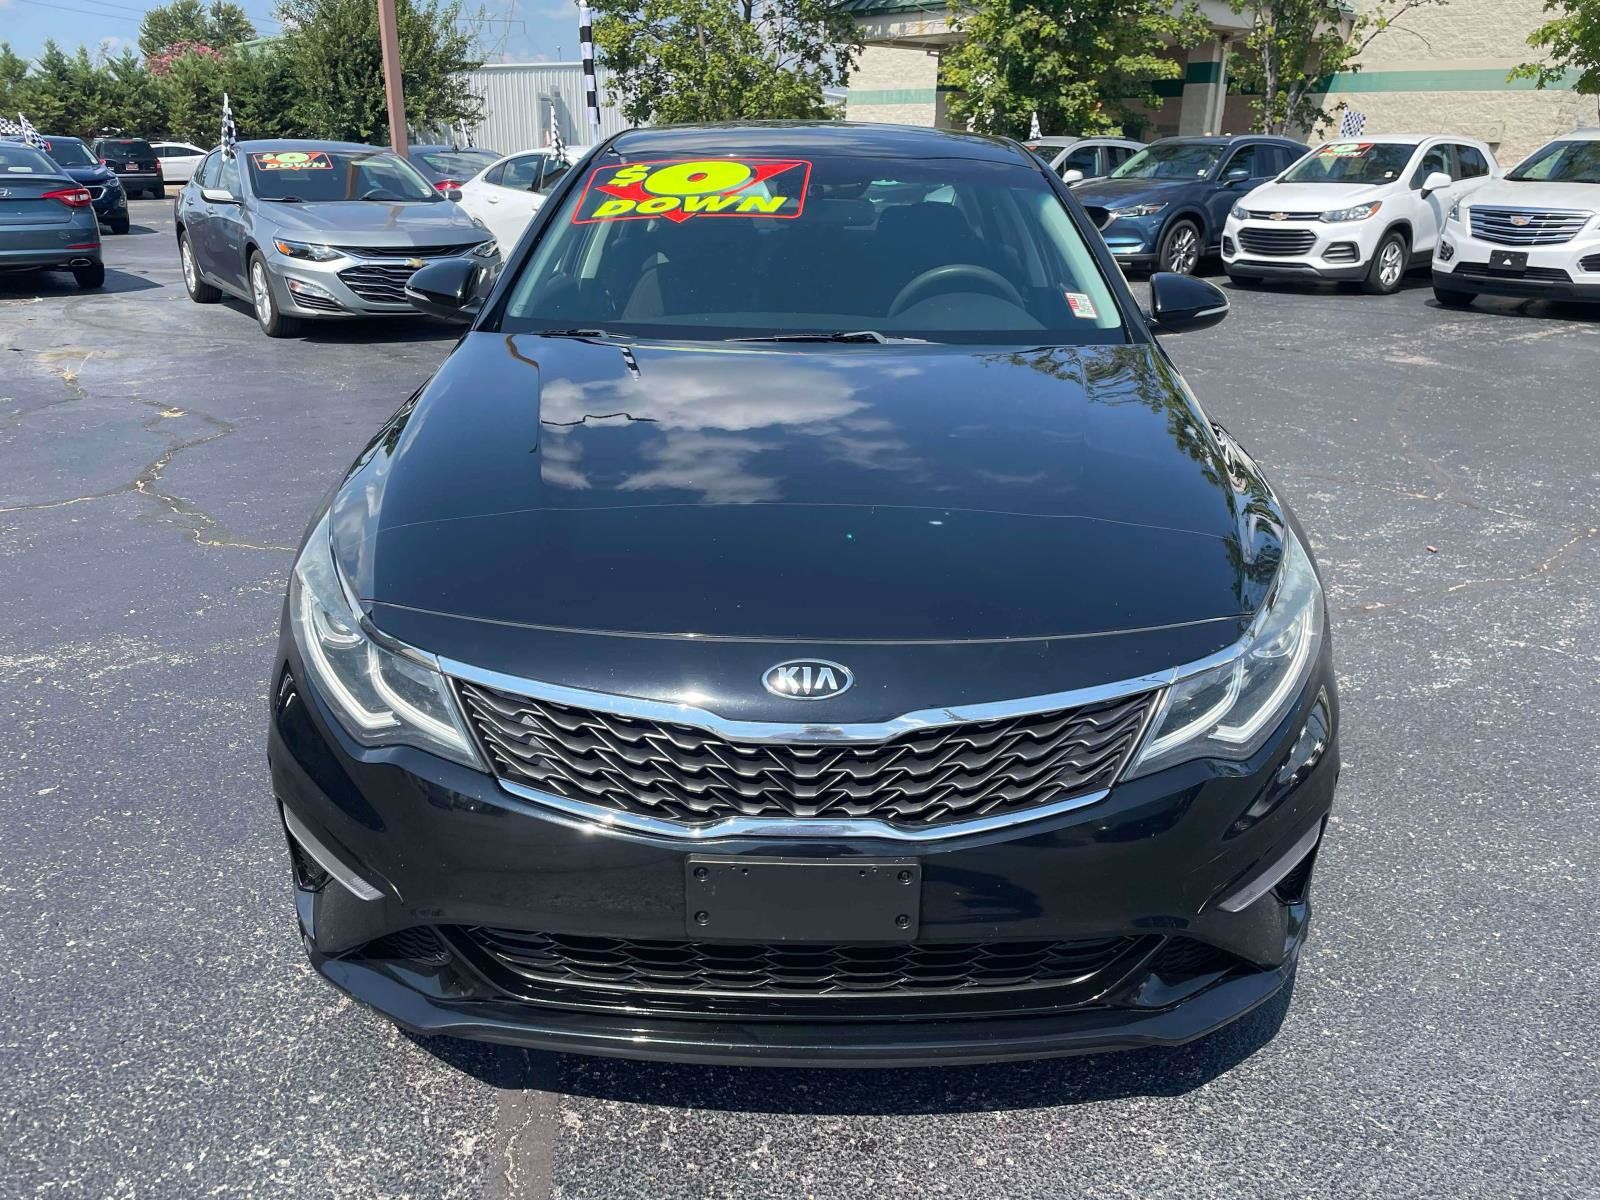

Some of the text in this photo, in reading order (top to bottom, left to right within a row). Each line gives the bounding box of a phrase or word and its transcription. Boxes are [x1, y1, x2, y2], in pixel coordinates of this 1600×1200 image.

[608, 161, 751, 195] $0
[592, 196, 787, 217] DOWN
[777, 666, 838, 690] KIA
